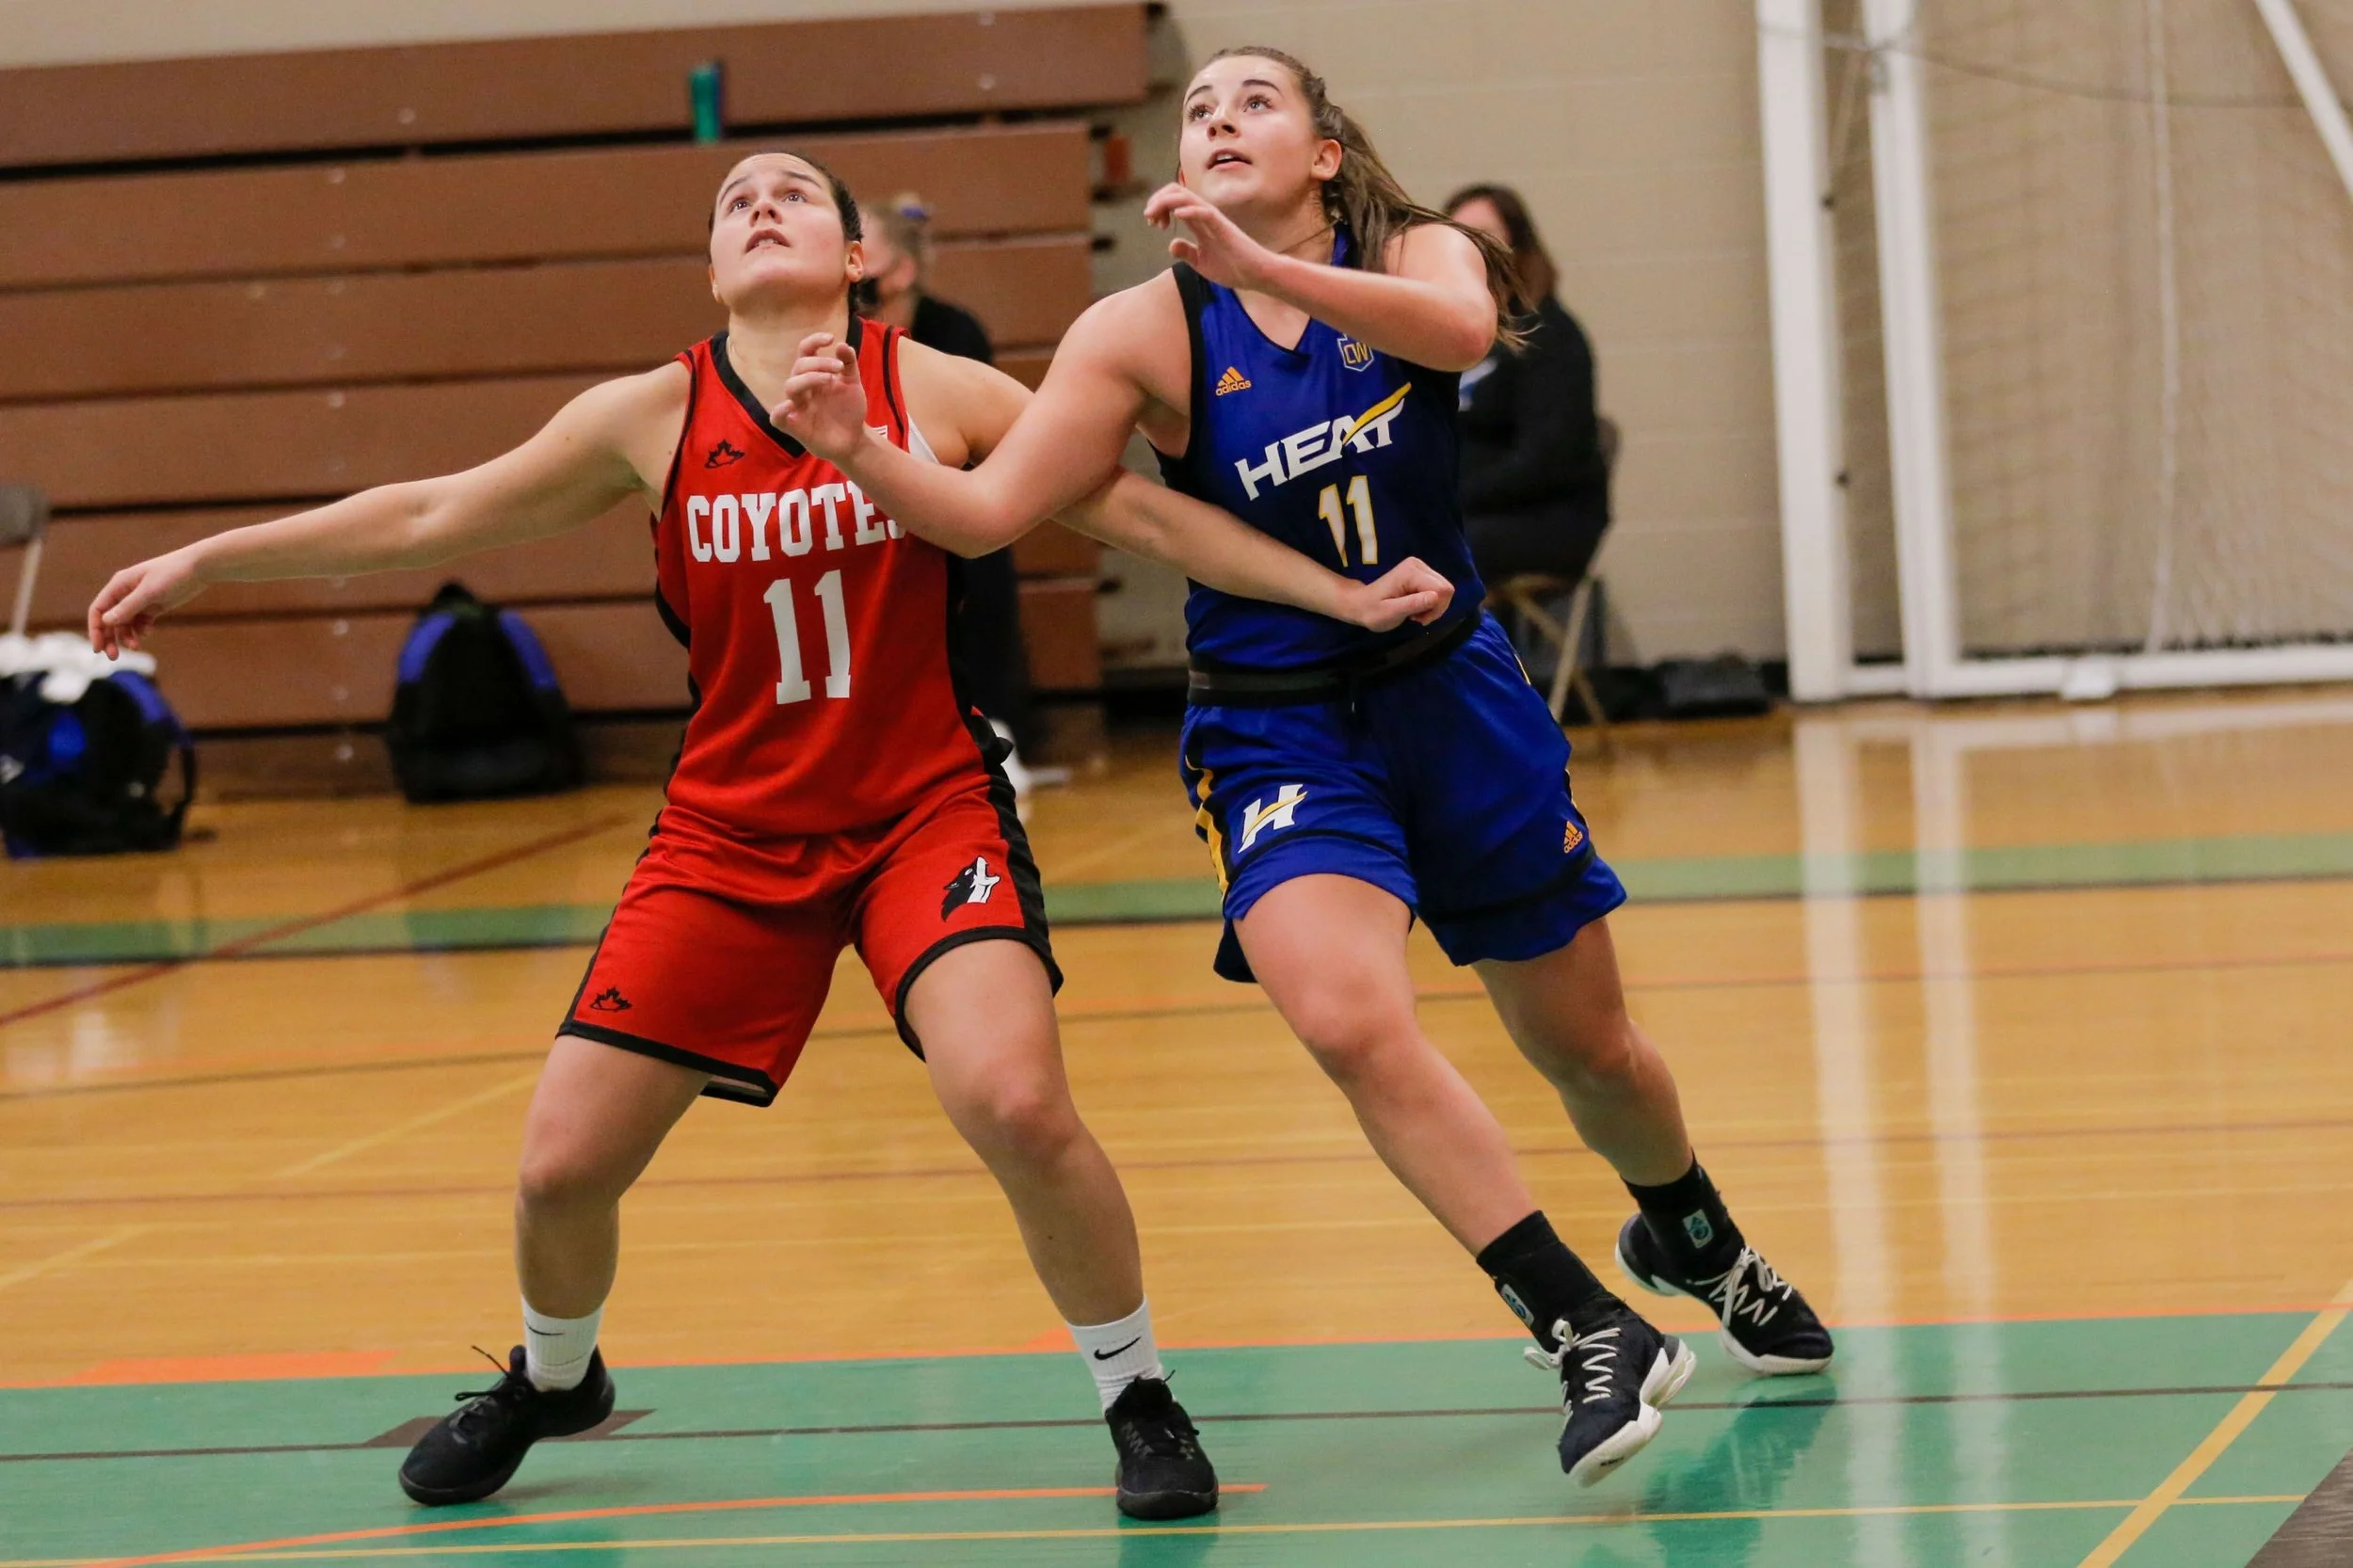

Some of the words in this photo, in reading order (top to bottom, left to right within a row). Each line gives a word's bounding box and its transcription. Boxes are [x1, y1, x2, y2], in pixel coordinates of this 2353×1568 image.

[1215, 379, 1252, 396] adidas
[1234, 382, 1412, 501] HEAT
[686, 479, 905, 563] COYOTE
[1319, 474, 1379, 568] 11
[762, 568, 851, 705] 11
